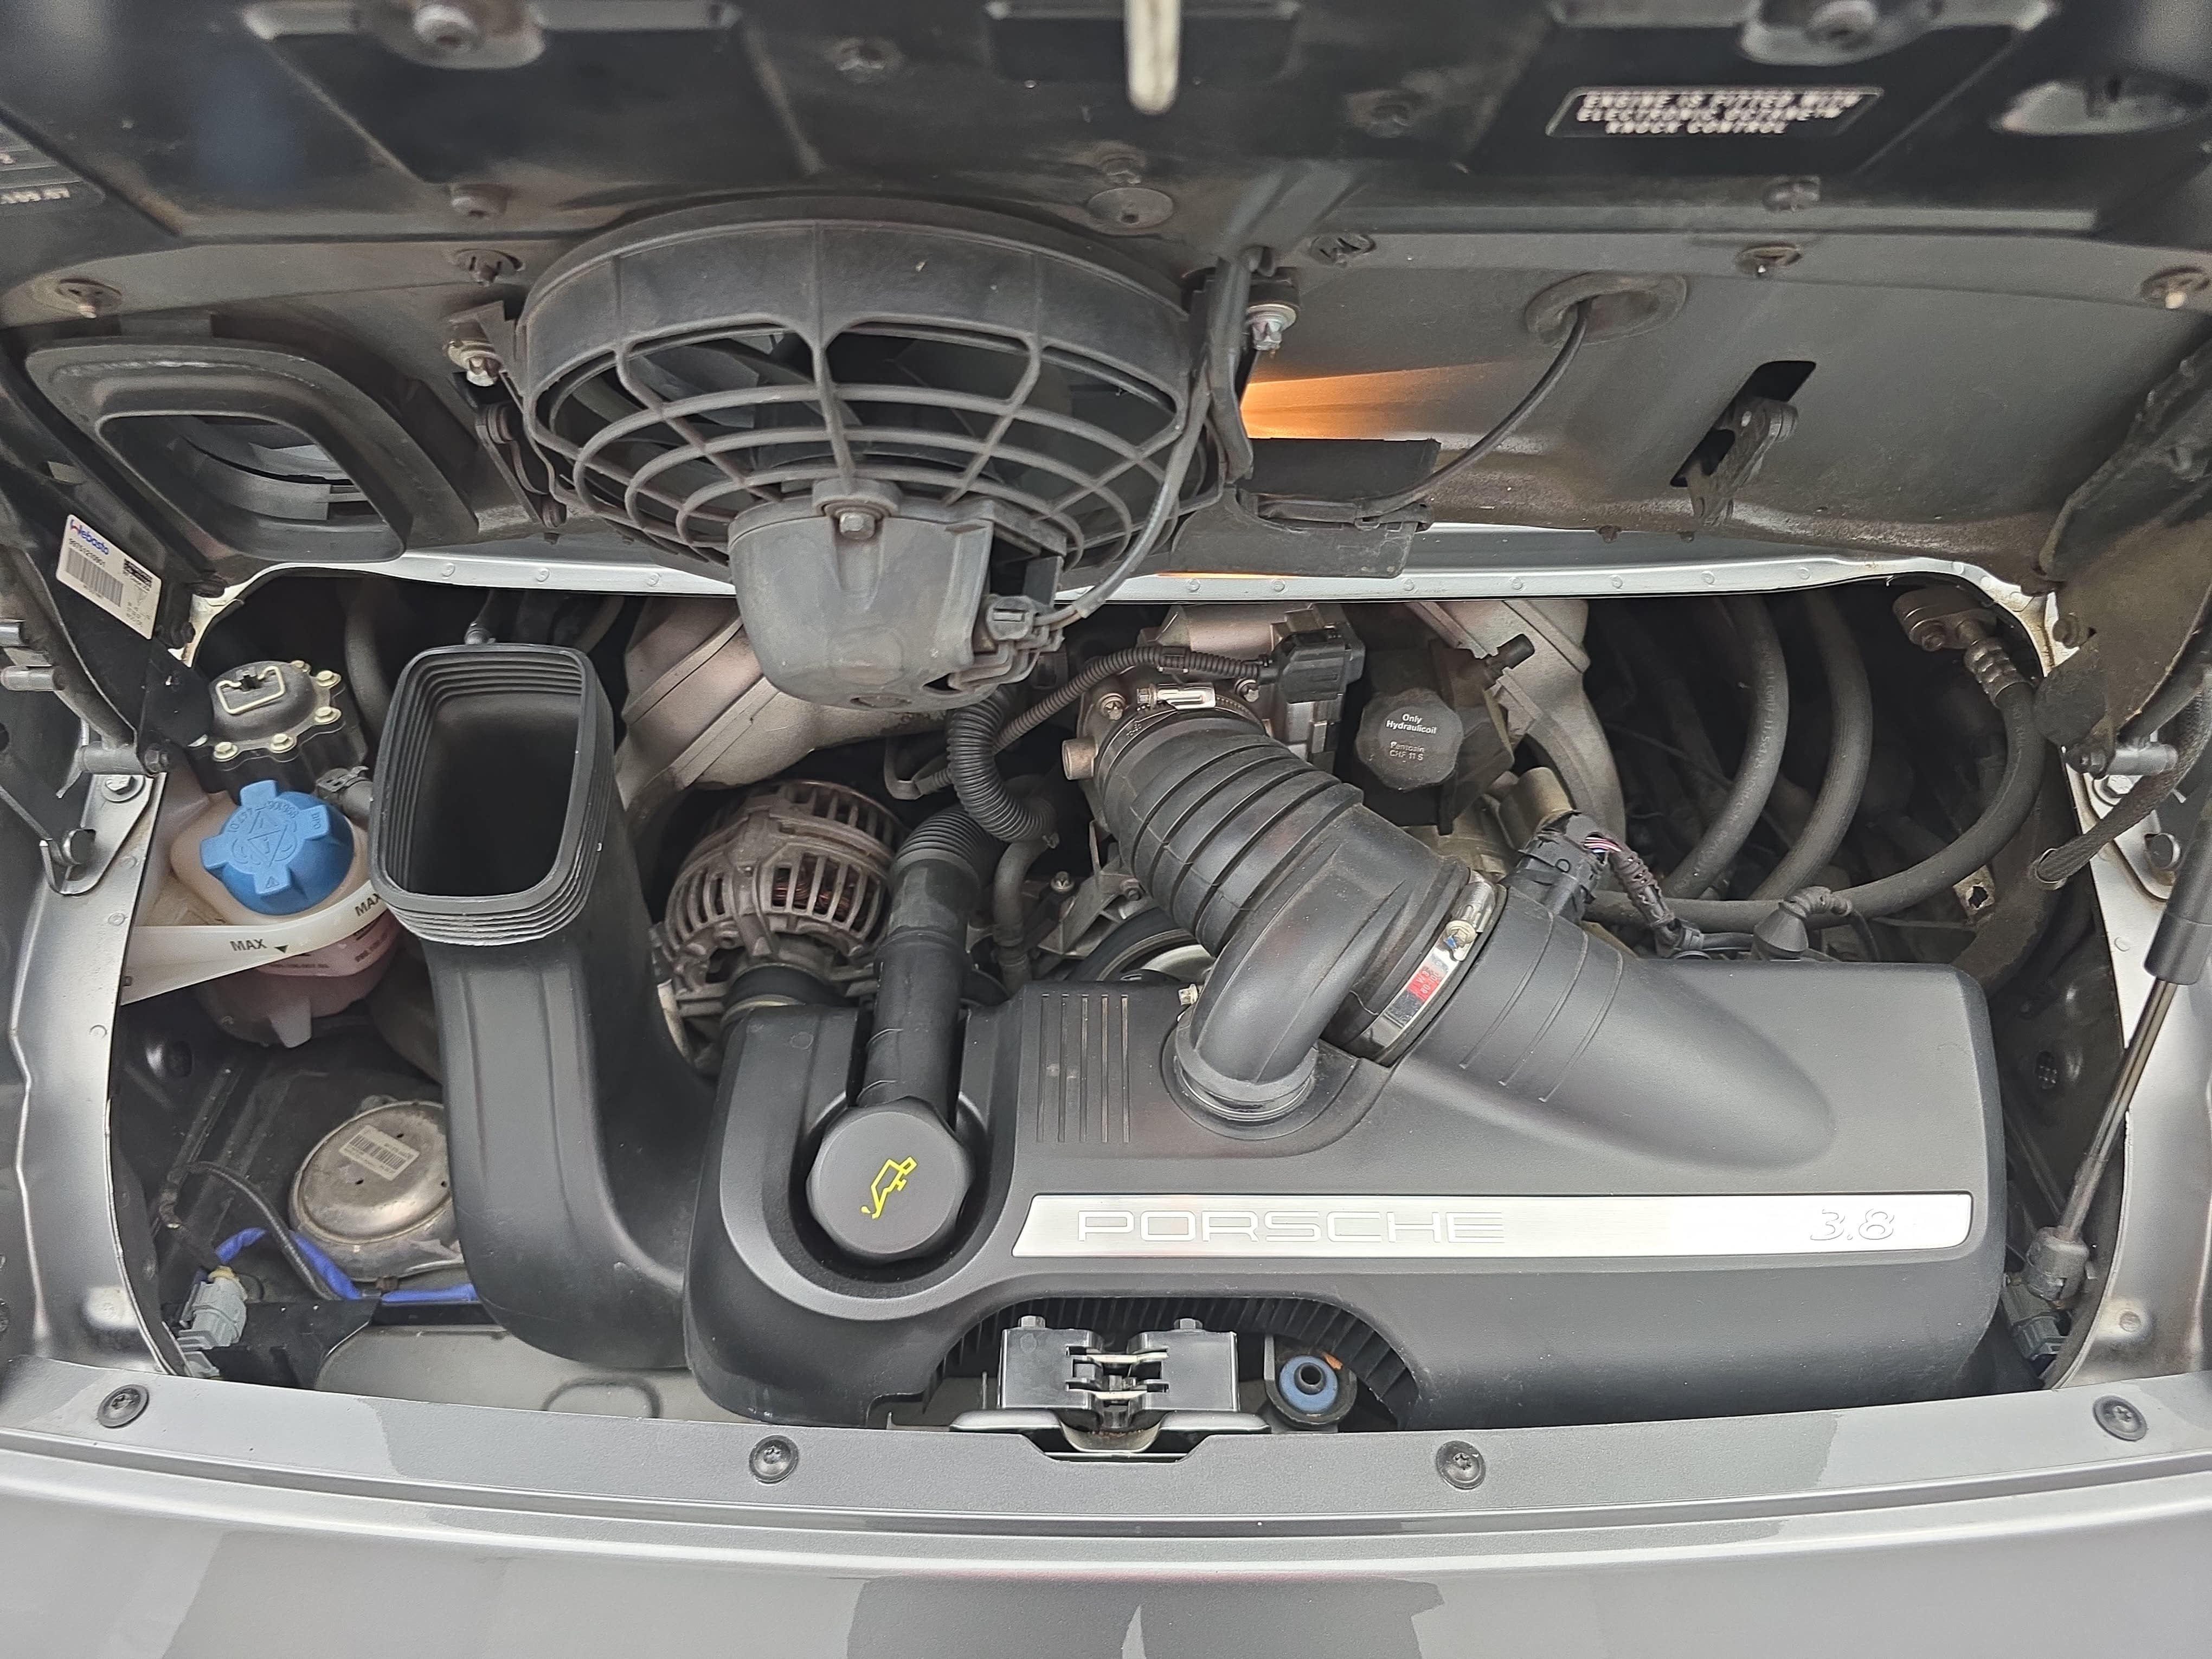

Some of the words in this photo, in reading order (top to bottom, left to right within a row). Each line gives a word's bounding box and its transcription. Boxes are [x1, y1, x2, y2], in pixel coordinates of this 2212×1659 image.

[1583, 91, 1671, 108] ENGINE
[1605, 120, 1683, 134] KNOCK
[1687, 120, 1789, 134] CONTROL
[70, 519, 109, 555] Webasto
[1402, 713, 1423, 724] Only
[1386, 720, 1437, 734] Hydraulicoil
[355, 893, 381, 916] MAX
[230, 938, 267, 951] MAX
[1078, 1210, 1505, 1243] PORSCHE
[1810, 1208, 1895, 1241] 3.8
